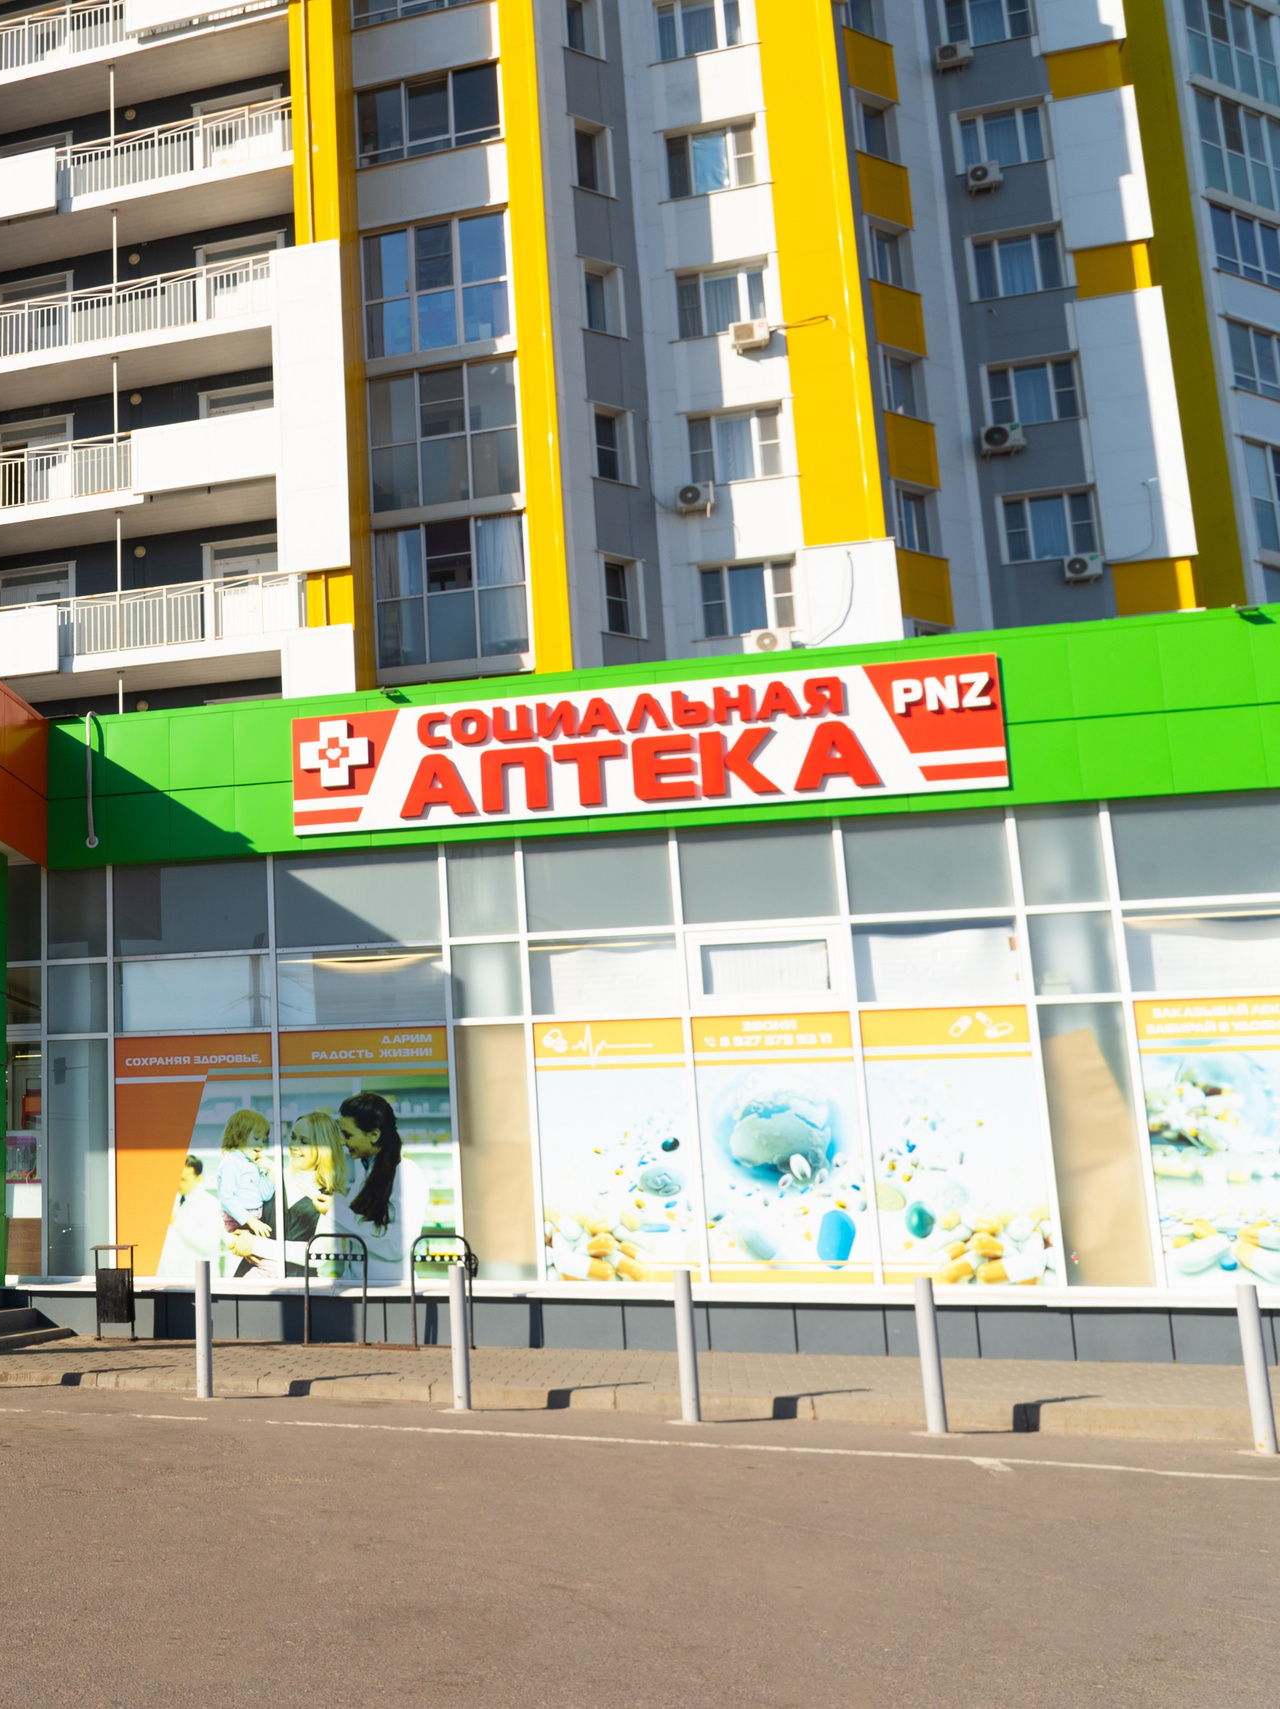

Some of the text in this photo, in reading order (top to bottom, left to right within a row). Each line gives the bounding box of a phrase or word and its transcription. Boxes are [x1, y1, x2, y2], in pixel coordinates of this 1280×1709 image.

[890, 671, 994, 714] PNZ
[417, 676, 846, 748] СОЦИАЛЬНАЯ
[399, 720, 882, 818] АПТЕКА
[381, 1033, 433, 1044] ДАРИМ
[125, 1053, 263, 1067] СОХРАНЯЯ ЗДОРОВЬЕ,
[311, 1047, 433, 1060] РАДОСТЬ ЖИЗНИ!
